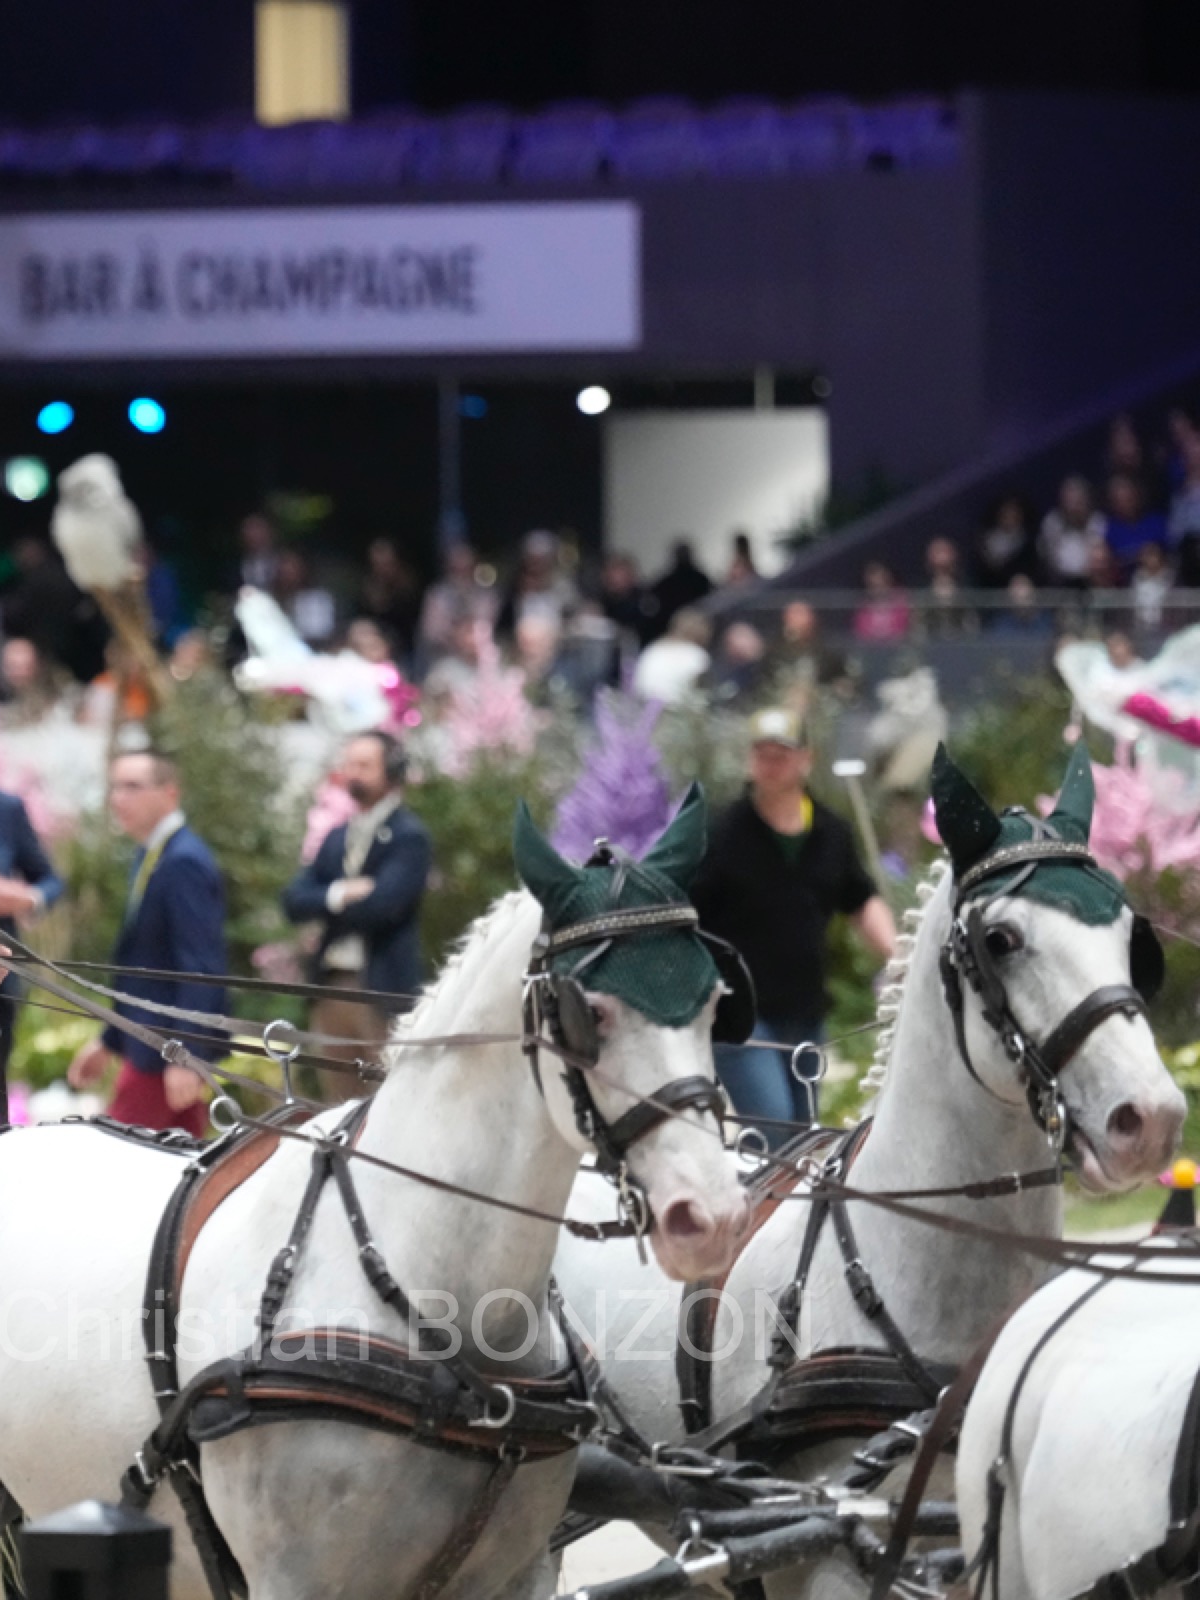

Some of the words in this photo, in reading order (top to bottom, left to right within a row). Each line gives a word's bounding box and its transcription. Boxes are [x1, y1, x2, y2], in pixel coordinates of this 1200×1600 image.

[19, 251, 118, 320] BAR
[133, 232, 169, 313] À
[175, 244, 479, 318] CHAMPAGNE
